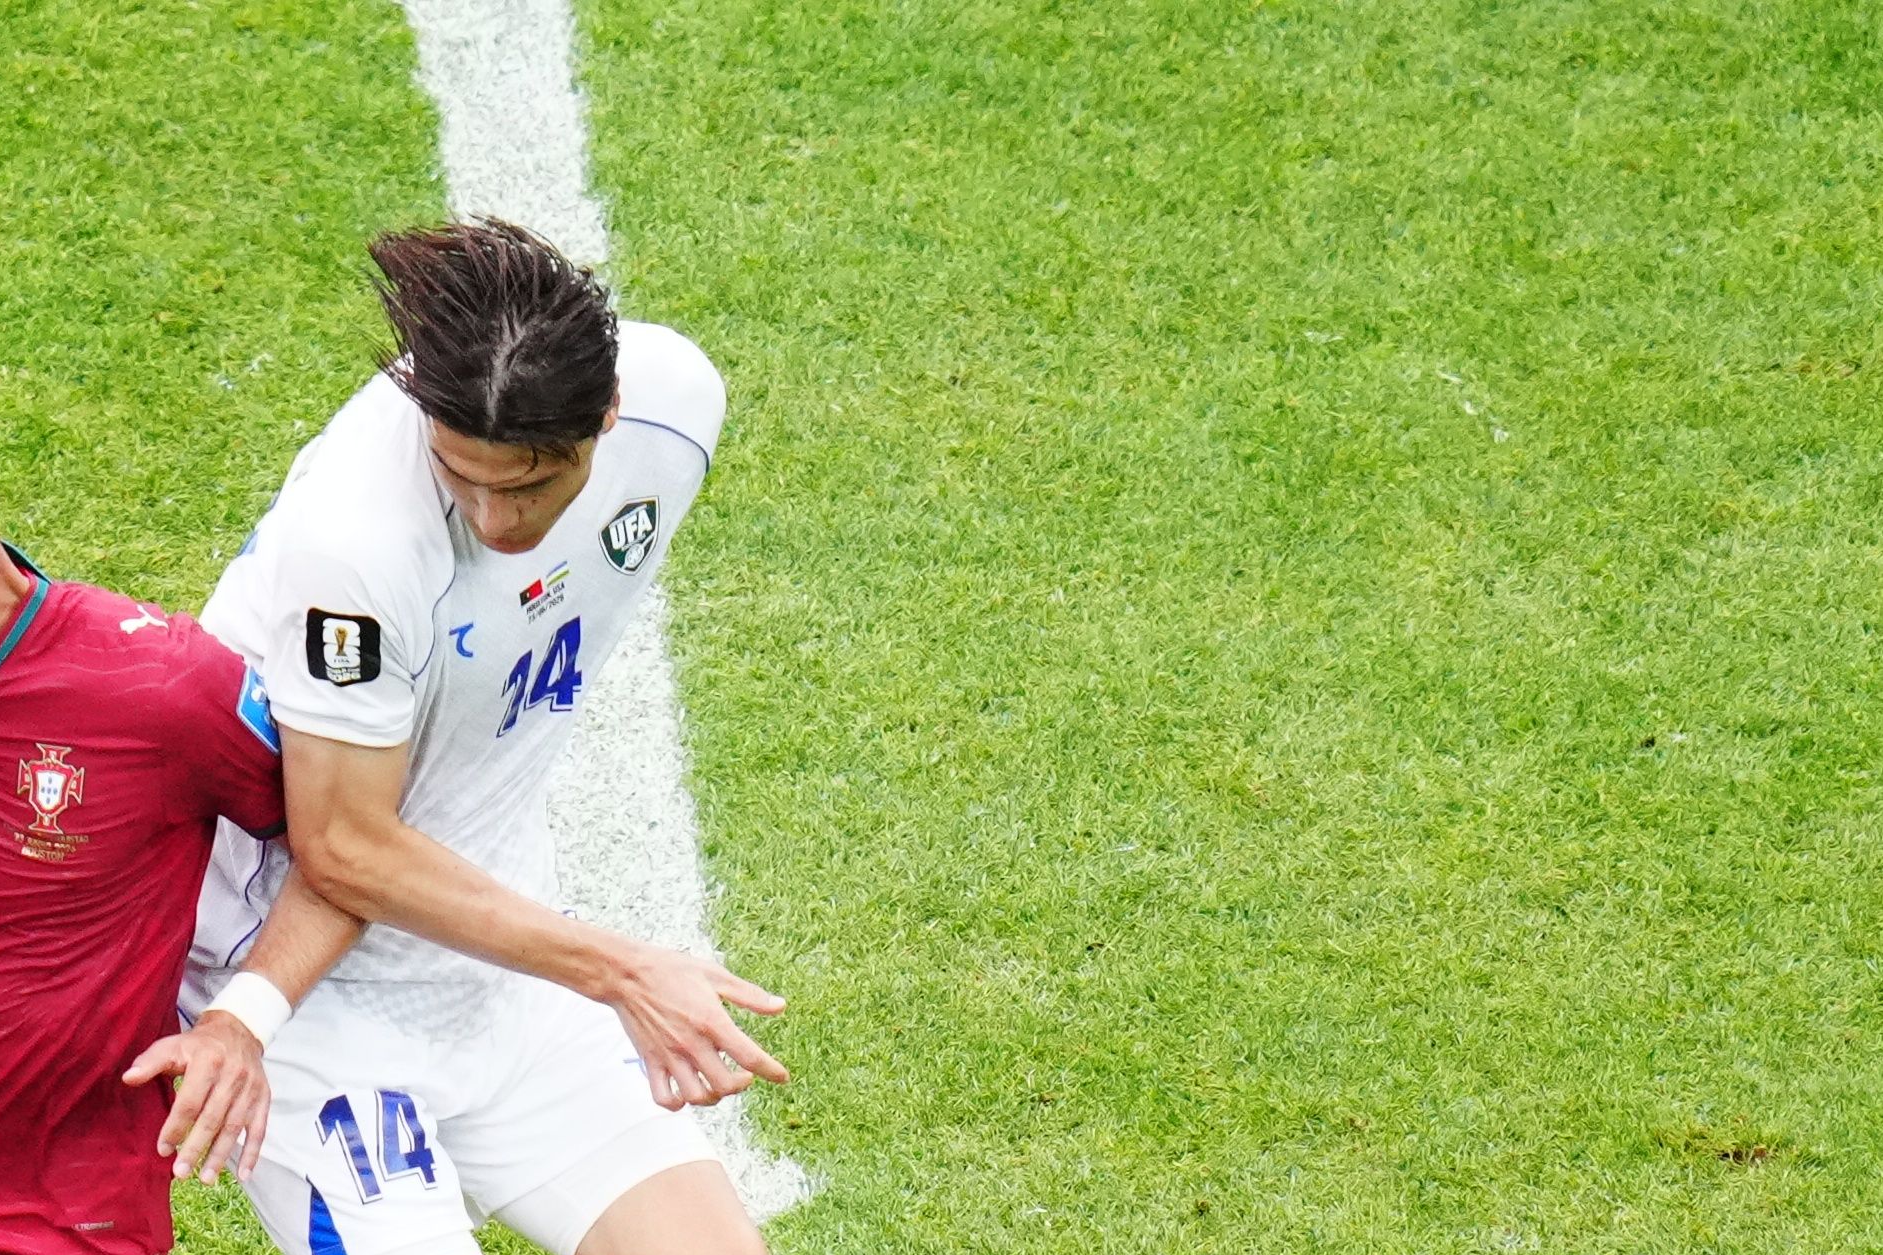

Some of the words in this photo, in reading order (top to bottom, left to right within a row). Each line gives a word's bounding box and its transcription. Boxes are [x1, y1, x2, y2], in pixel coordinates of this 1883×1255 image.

[609, 509, 653, 551] UFA
[495, 612, 583, 738] 14
[21, 846, 65, 863] HOUSTON
[314, 1089, 438, 1206] 14
